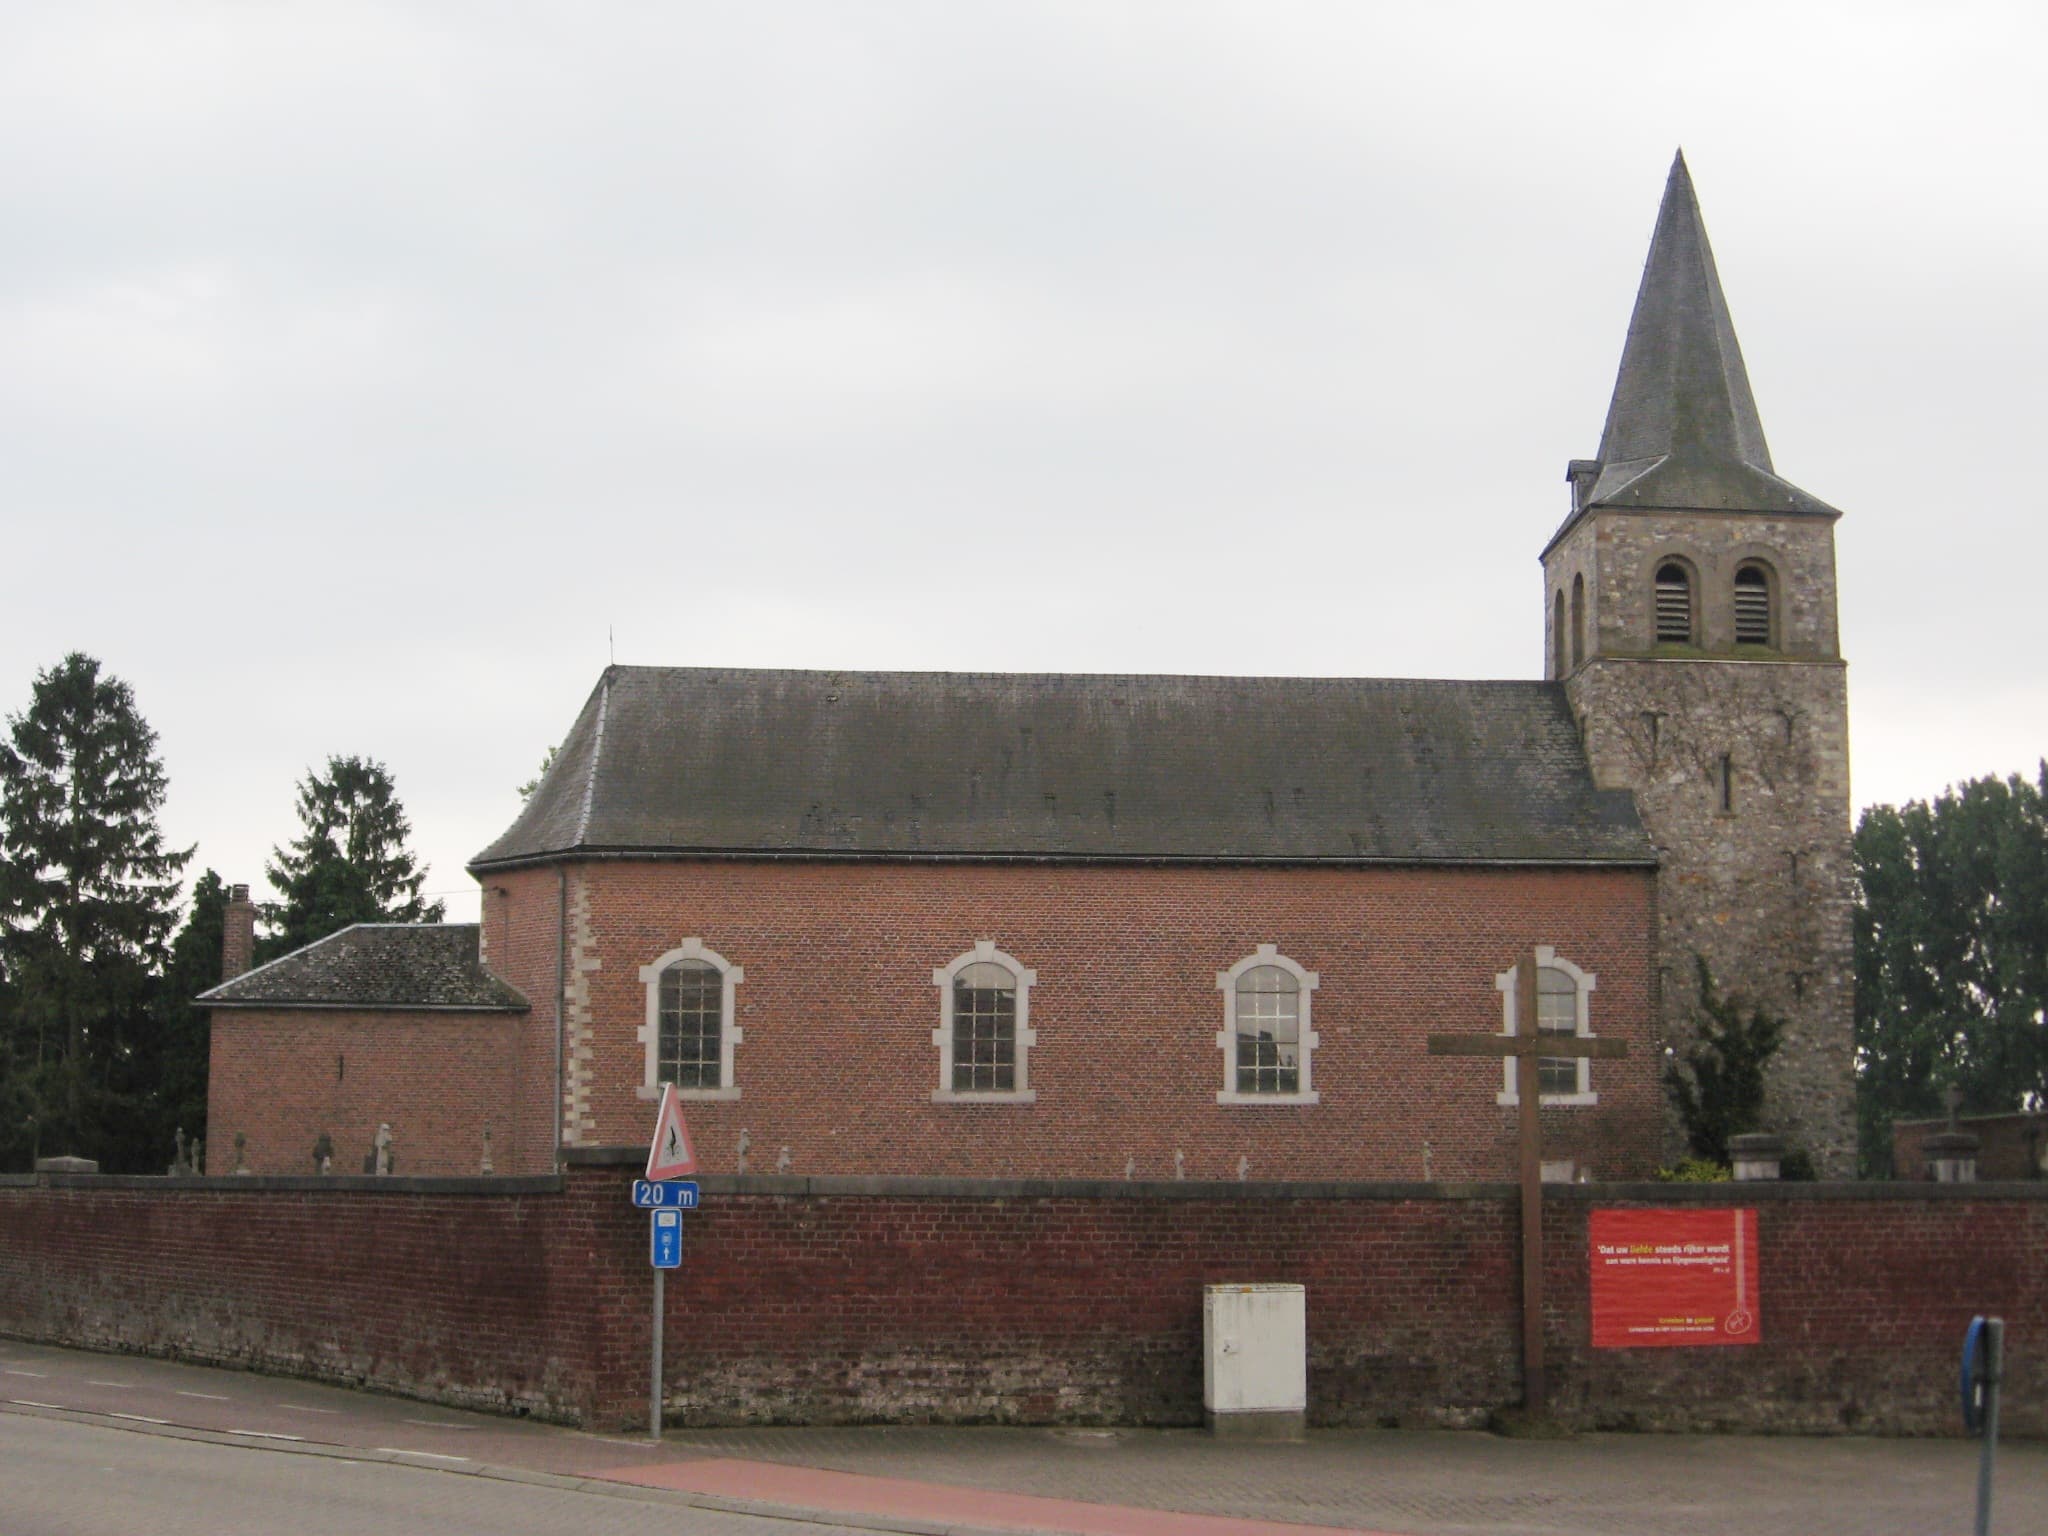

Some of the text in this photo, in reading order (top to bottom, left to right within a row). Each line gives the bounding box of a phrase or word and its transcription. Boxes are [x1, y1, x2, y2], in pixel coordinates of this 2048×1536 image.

[641, 1184, 692, 1205] 20 m
[1655, 1245, 1682, 1254] steeds
[1706, 1244, 1730, 1254] wordt
